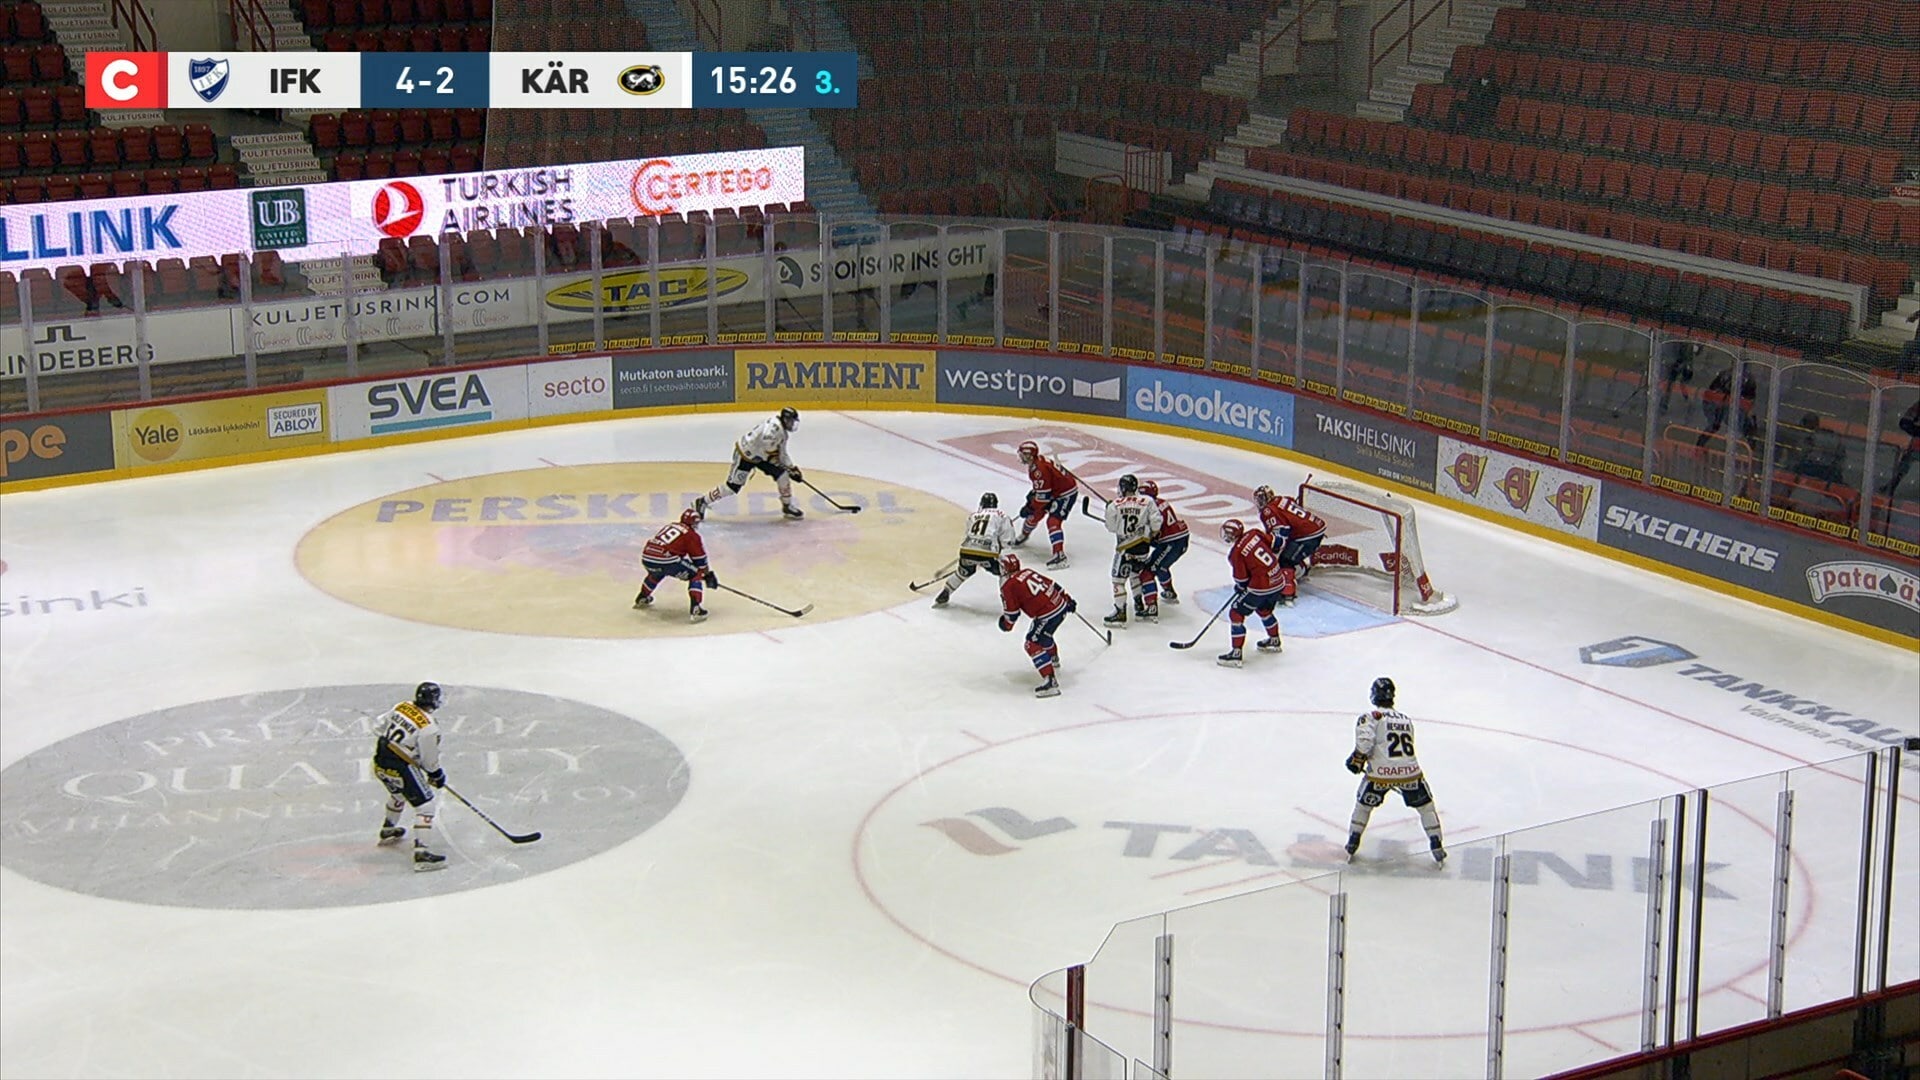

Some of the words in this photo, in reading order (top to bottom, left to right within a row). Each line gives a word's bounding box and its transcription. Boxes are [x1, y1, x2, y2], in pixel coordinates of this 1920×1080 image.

[440, 168, 572, 203] TURKISH
[648, 166, 771, 201] CERTEGO
[257, 199, 300, 227] UB
[439, 198, 574, 235] AIRLINES
[0, 204, 182, 262] LLINK
[810, 253, 905, 282] SONSR
[911, 244, 987, 271] INSGHT
[604, 278, 688, 302] TAC
[0, 343, 154, 376] INDEBERG
[620, 368, 674, 382] Mutkaton
[676, 364, 729, 379] autoarki.
[544, 376, 606, 398] secto
[747, 361, 924, 391] RAMIRENT
[945, 368, 1067, 399] westpro
[368, 374, 492, 420] SVEA
[1135, 380, 1285, 437] ebookers.fi
[273, 409, 306, 421] SECURED
[307, 407, 318, 417] BY
[274, 417, 318, 434] ABLOY
[0, 424, 67, 477] pe
[135, 424, 180, 446] Yale
[1316, 412, 1417, 459] TAKSIHELSINKI
[375, 489, 917, 524] PERSKINDOL
[971, 517, 989, 536] 41
[1122, 514, 1139, 535] 13
[1603, 505, 1780, 573] SKECHERS
[1254, 547, 1274, 567] 6
[1823, 567, 1877, 593] pata
[1677, 662, 1912, 748] TANKKAU
[1386, 731, 1415, 758] 26
[59, 745, 601, 807] QUATY
